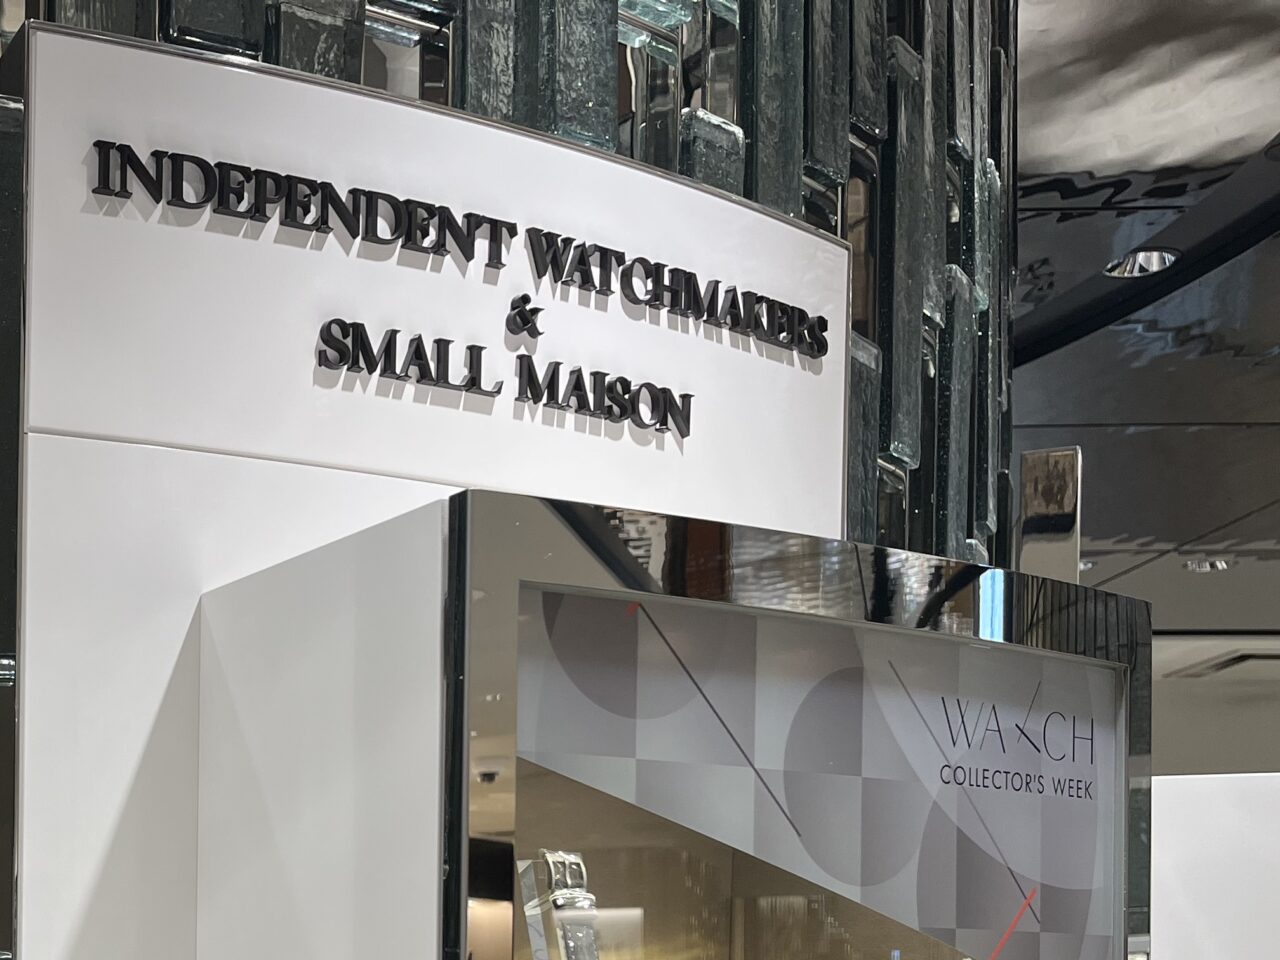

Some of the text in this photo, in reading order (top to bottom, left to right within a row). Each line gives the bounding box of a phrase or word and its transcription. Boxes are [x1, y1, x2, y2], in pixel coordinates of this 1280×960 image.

[91, 139, 829, 359] INDEPENDENT WATCHMAKERS
[508, 293, 545, 339] &
[318, 317, 695, 439] SMALL MAISON
[940, 764, 1093, 800] COLLECTOR'S WEEK
